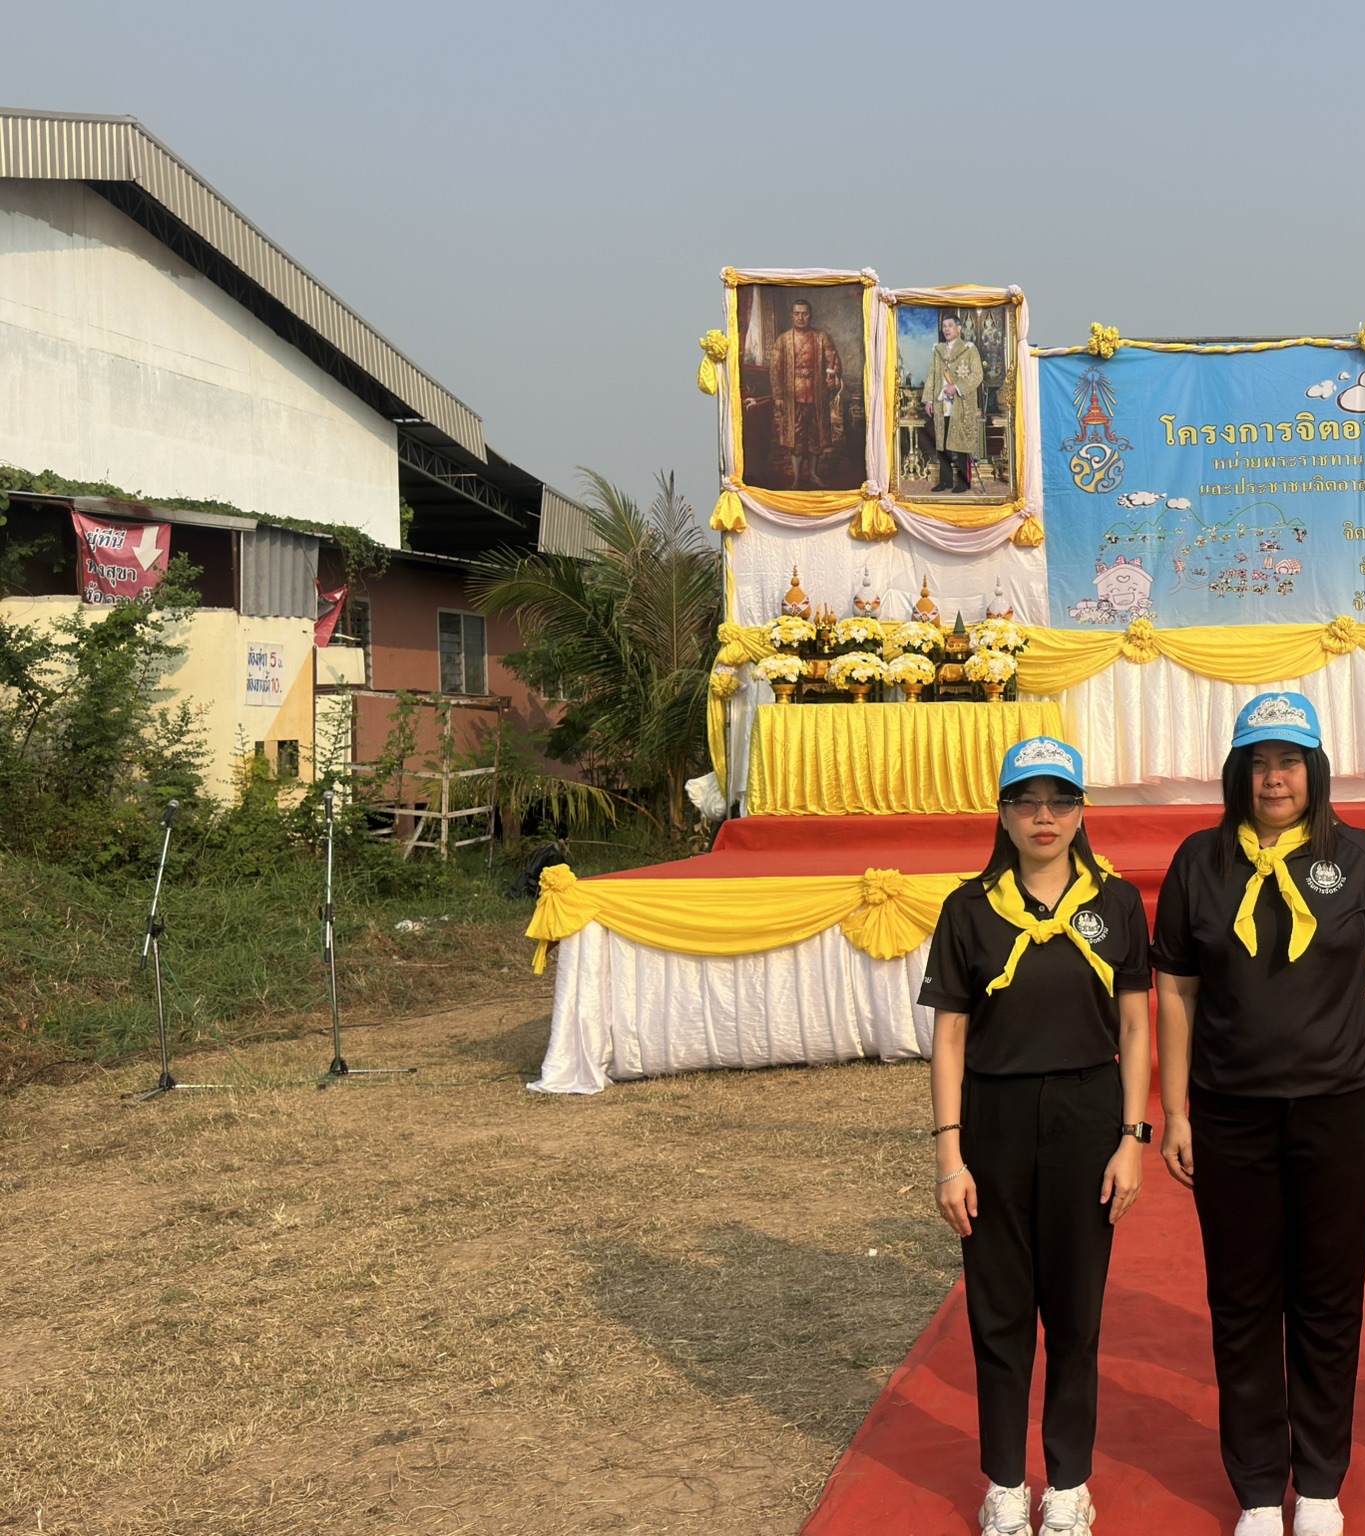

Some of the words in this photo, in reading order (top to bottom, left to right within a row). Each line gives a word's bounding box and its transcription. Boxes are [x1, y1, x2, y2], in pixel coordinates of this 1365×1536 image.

[1212, 450, 1364, 471] หน่วยพระราชทาน
[86, 526, 126, 553] ยู่ที่นี่
[270, 651, 277, 668] 5
